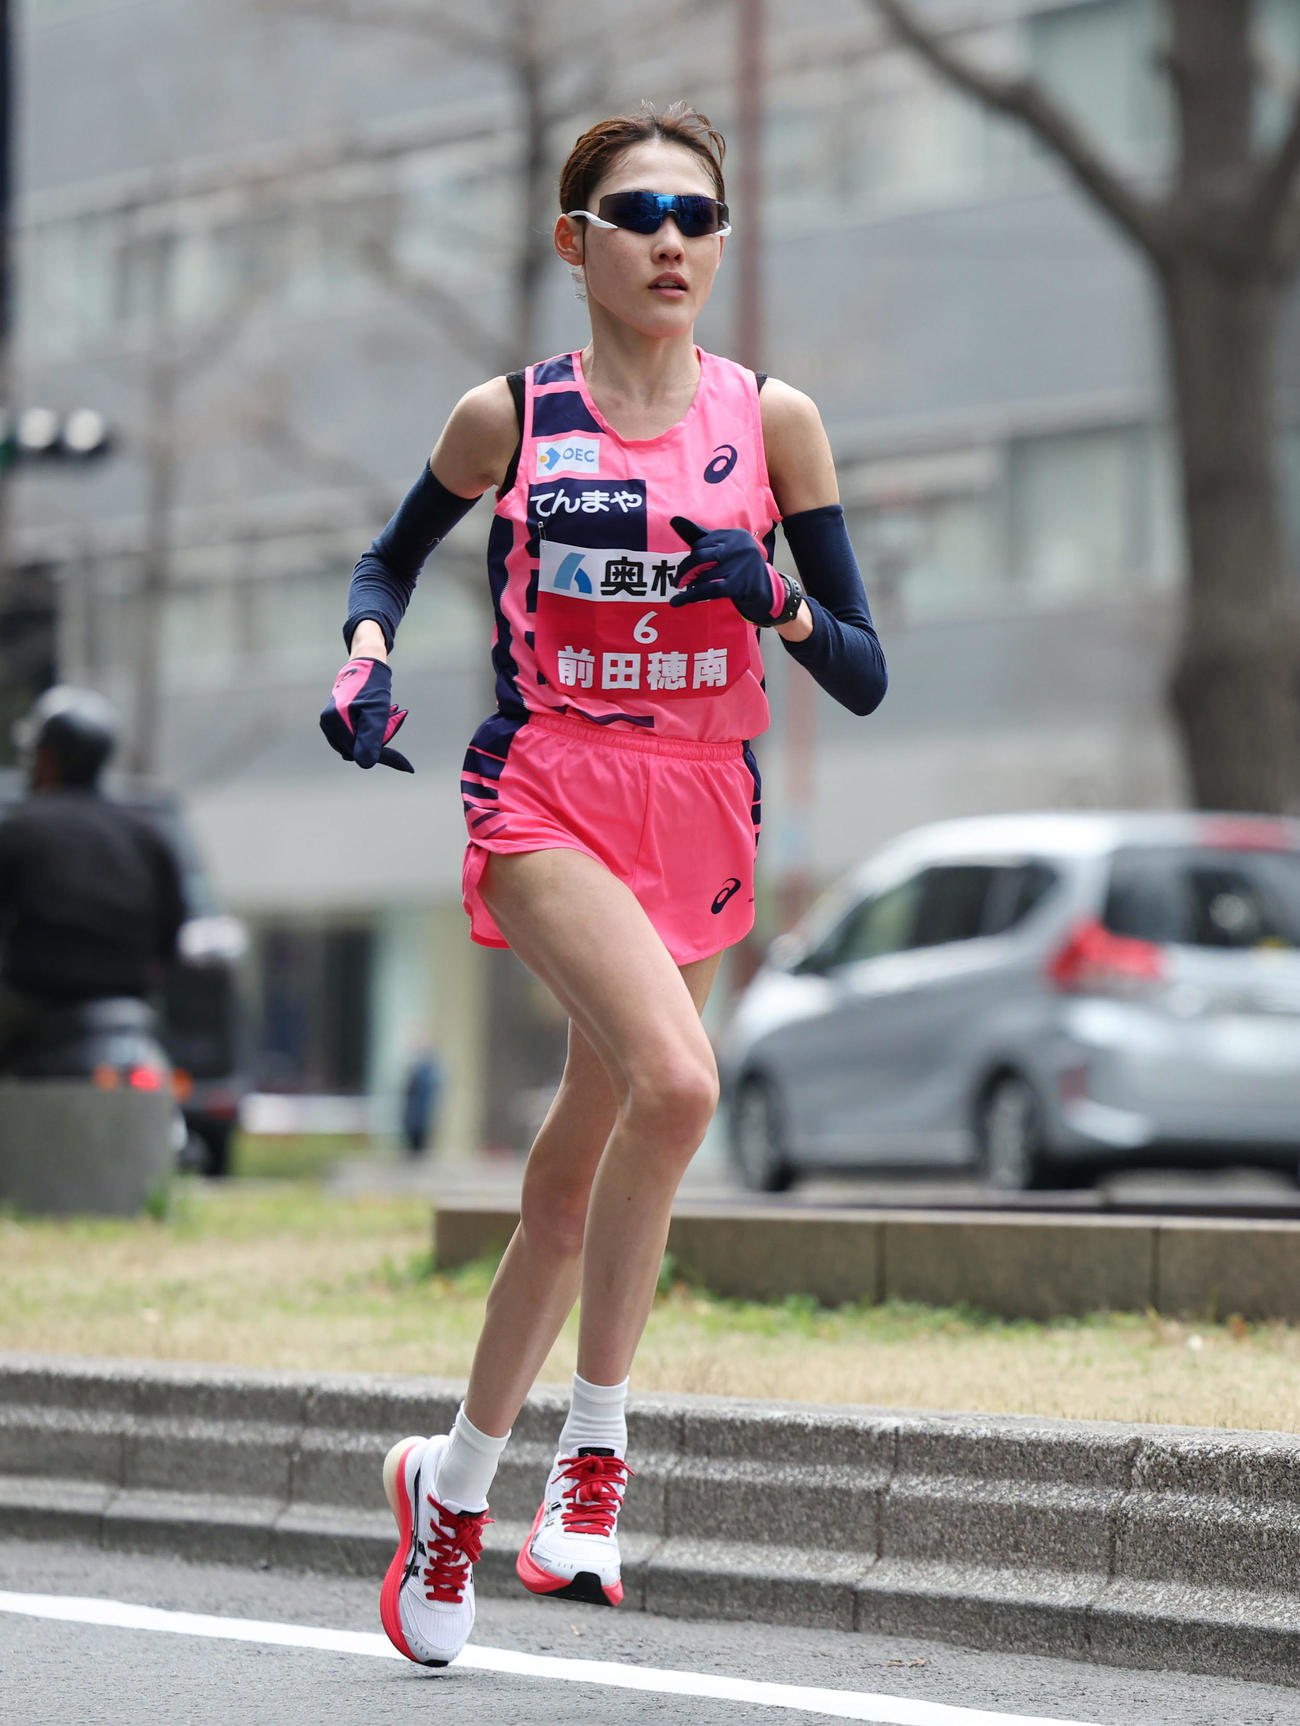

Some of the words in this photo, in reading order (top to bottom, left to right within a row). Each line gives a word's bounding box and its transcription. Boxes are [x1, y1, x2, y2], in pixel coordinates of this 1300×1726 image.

[563, 447, 595, 463] OEC
[530, 489, 642, 517] てんまや
[633, 611, 658, 644] 6
[557, 646, 728, 690] 前田穂南
